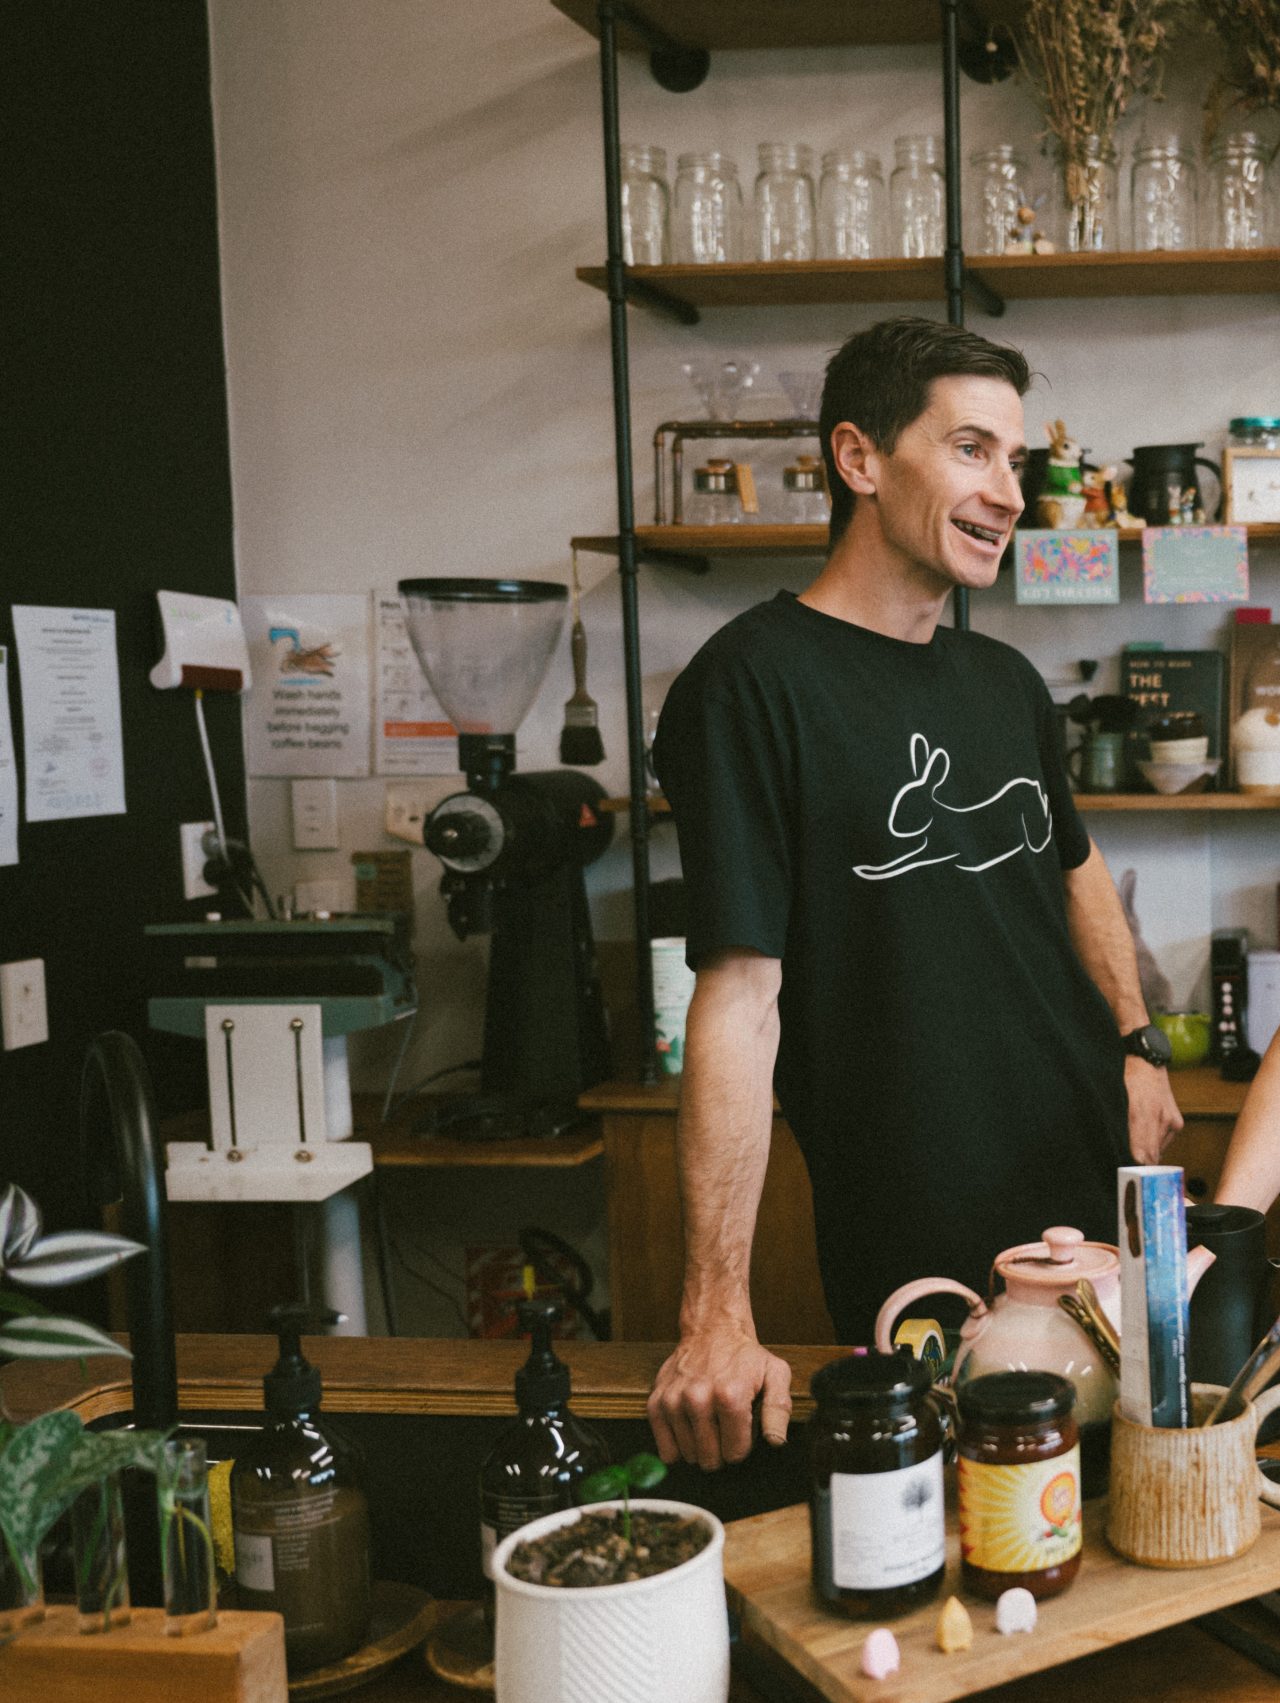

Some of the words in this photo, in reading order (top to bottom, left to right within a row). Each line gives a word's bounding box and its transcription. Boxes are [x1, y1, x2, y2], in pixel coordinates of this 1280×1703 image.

[1129, 673, 1163, 689] THE
[272, 690, 304, 700] Wash
[307, 690, 342, 700] hands
[274, 706, 340, 719] immediately
[267, 721, 301, 732] before
[305, 722, 350, 735] bagging
[271, 737, 304, 748] coffee
[307, 738, 342, 749] beans
